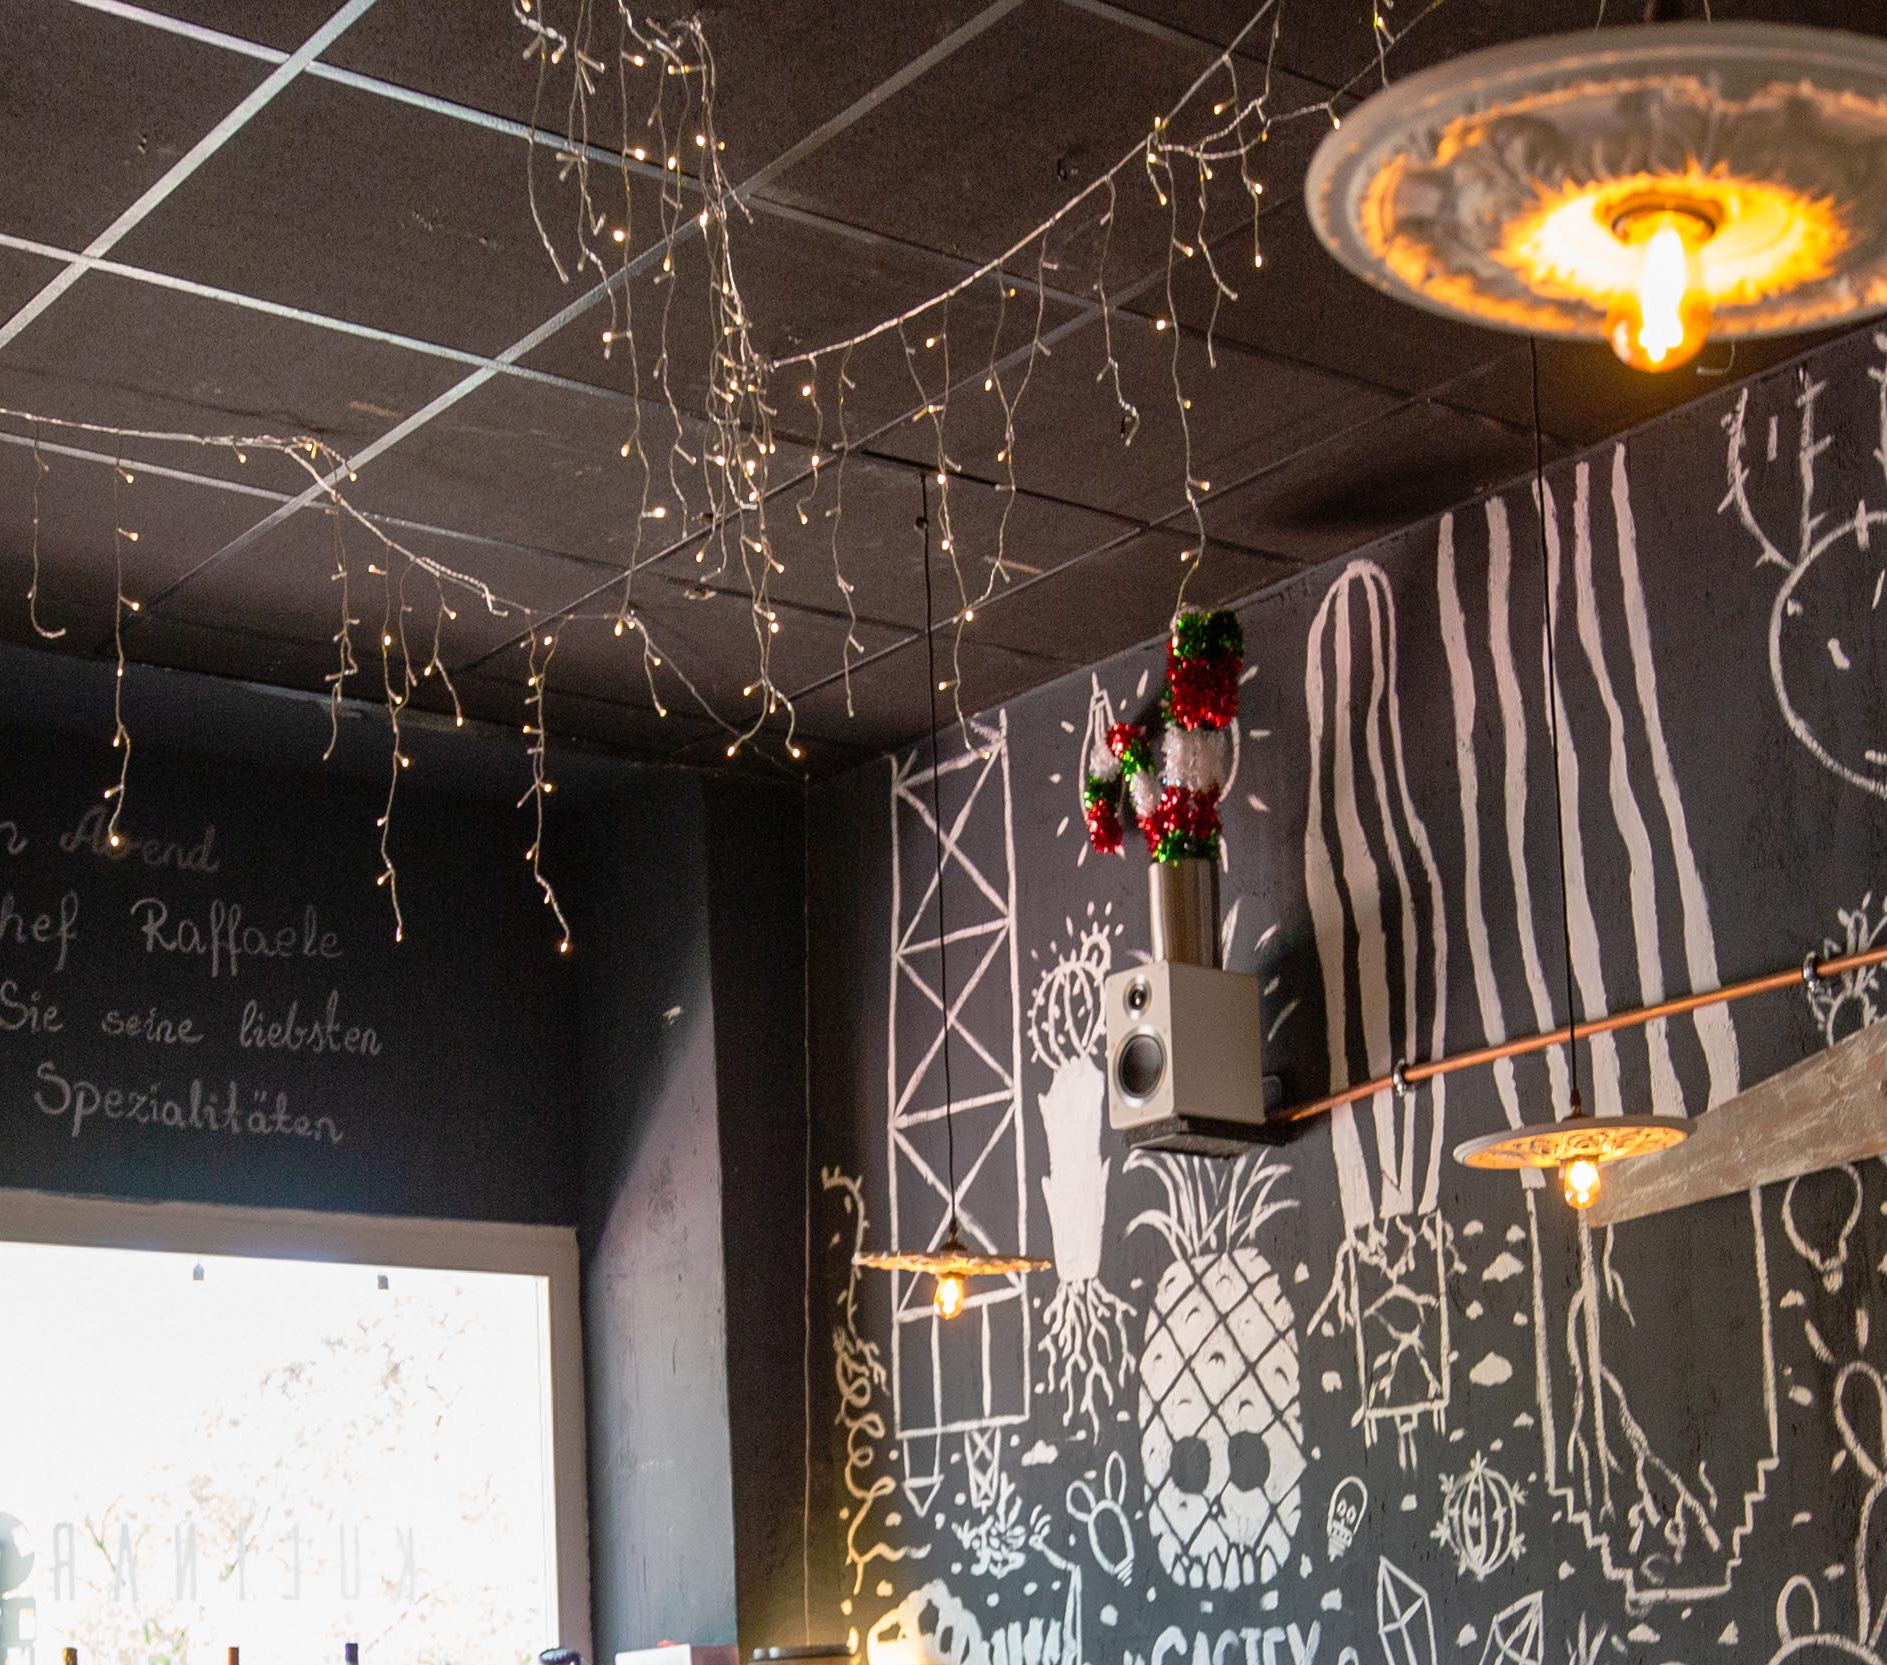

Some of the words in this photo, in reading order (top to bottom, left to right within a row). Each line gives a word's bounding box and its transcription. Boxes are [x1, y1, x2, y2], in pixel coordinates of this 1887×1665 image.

[130, 897, 345, 979] Raffaele
[101, 1006, 204, 1046] seine
[240, 989, 383, 1056] liebsten
[34, 1062, 345, 1145] Spezialitäten
